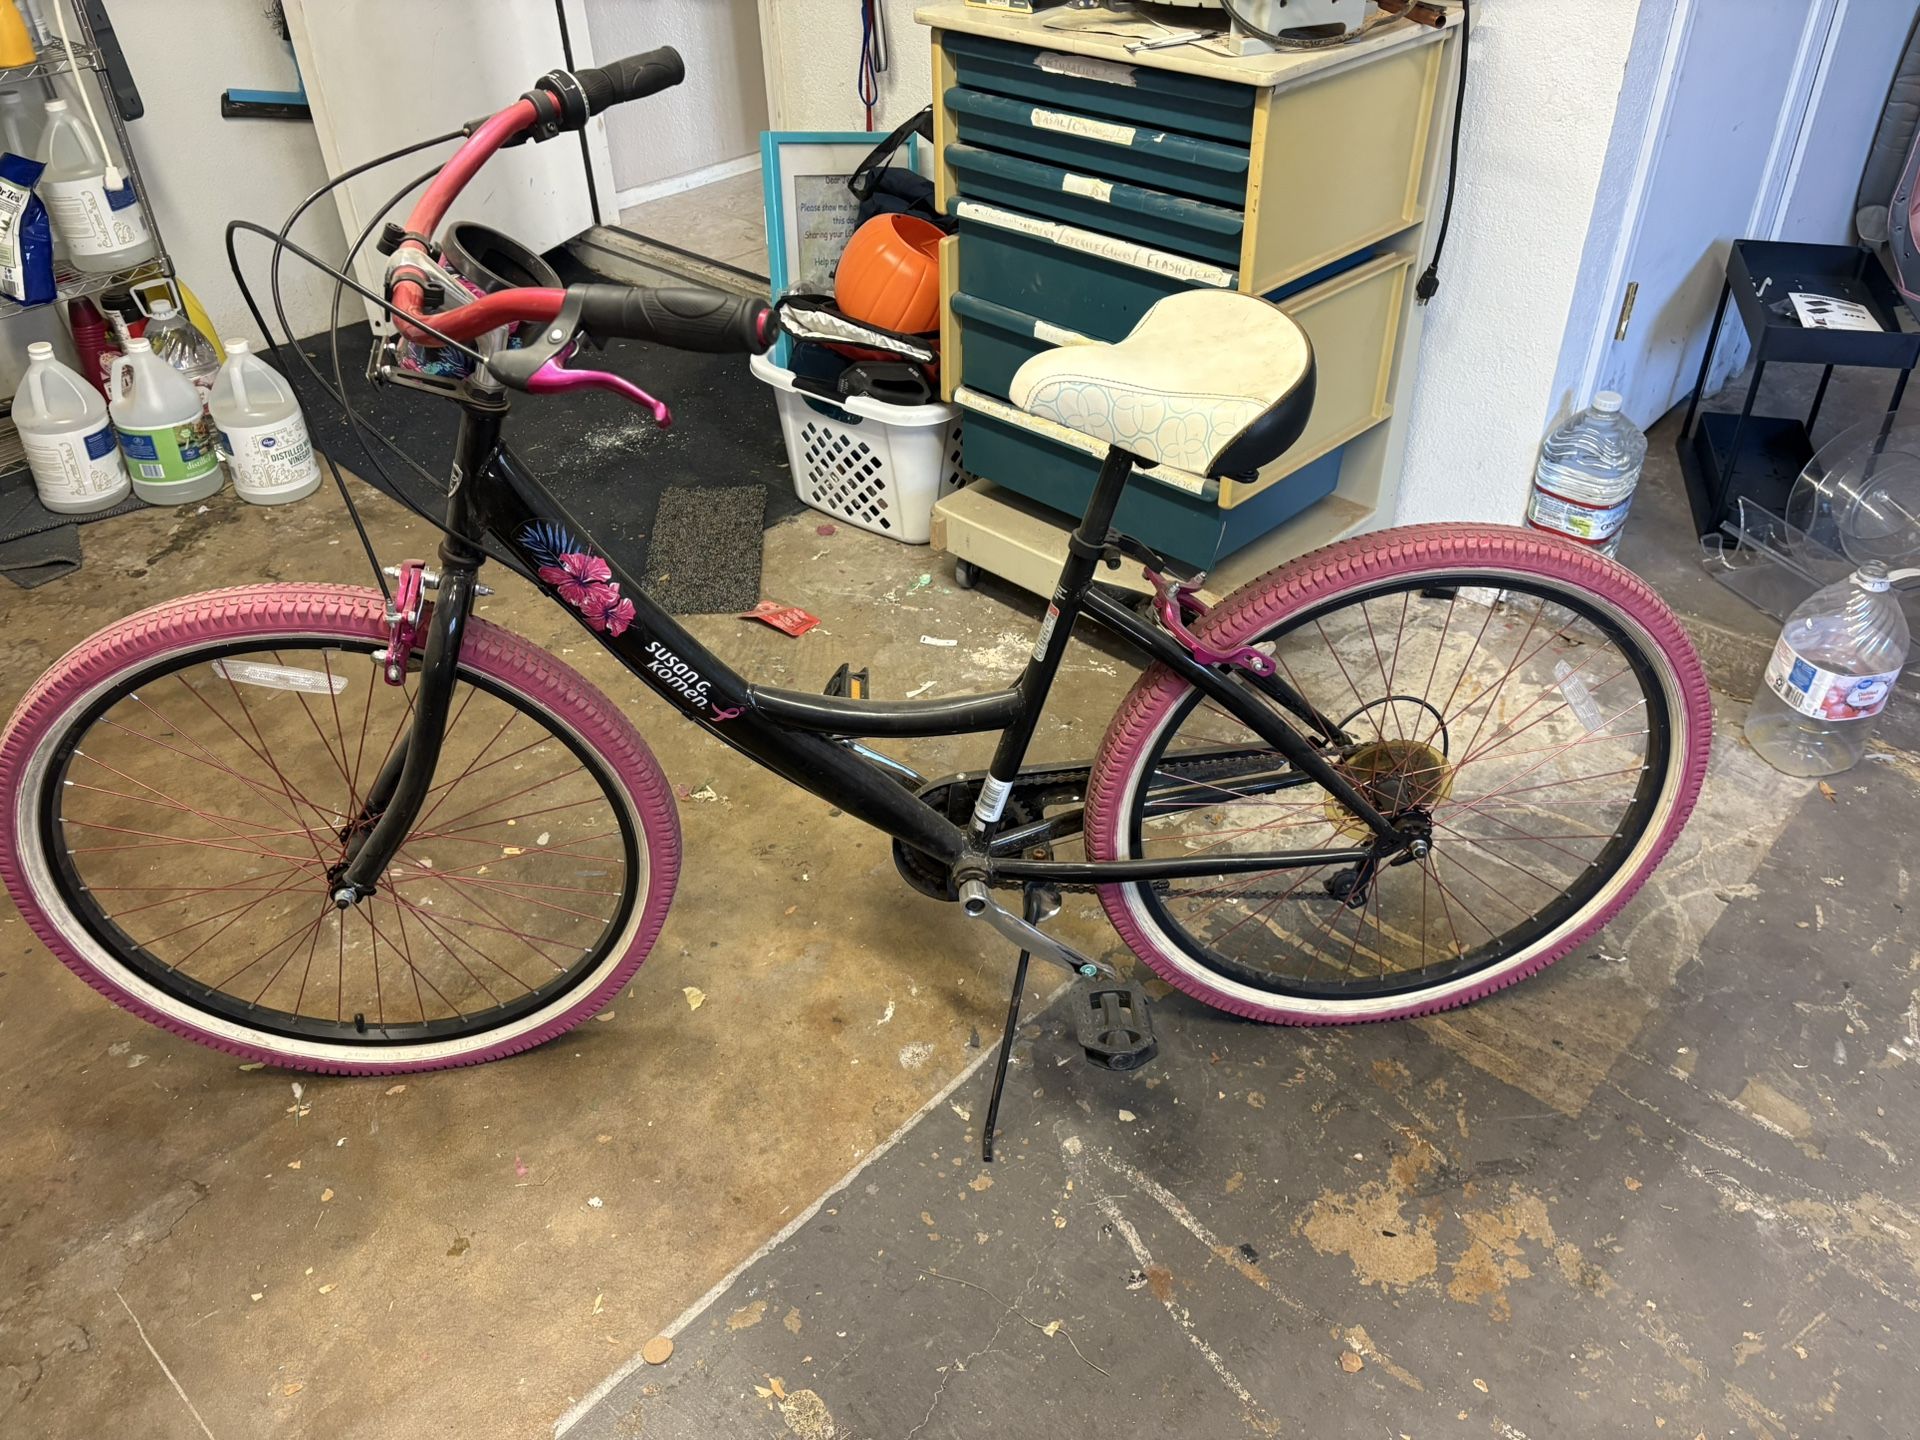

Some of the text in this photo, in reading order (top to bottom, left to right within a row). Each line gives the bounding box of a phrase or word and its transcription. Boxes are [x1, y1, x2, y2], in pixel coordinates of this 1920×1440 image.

[825, 174, 841, 184] Dear
[800, 202, 821, 212] Please
[821, 202, 837, 212] show
[838, 204, 848, 212] me
[832, 216, 846, 224] this
[804, 230, 829, 241] Sharing
[829, 231, 844, 241] your
[814, 257, 830, 268] Help
[270, 443, 304, 463] DISTILLED
